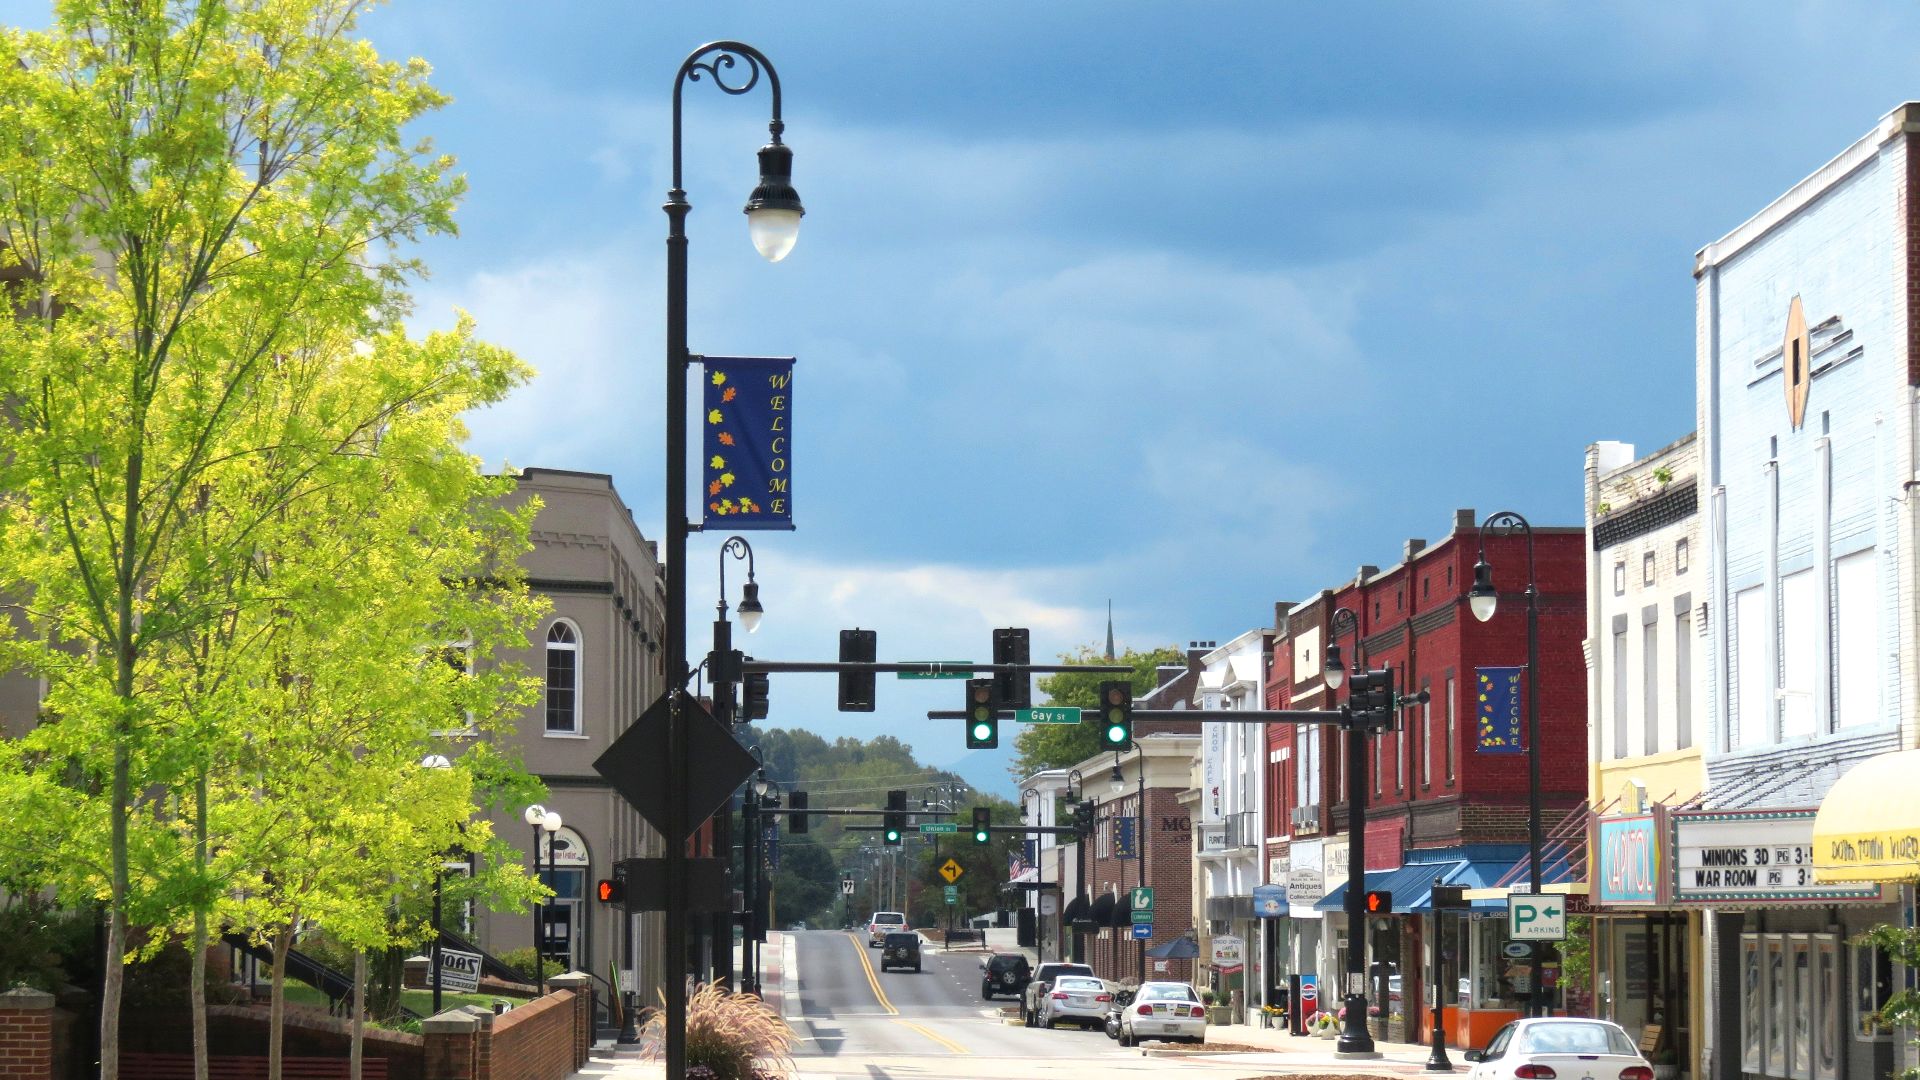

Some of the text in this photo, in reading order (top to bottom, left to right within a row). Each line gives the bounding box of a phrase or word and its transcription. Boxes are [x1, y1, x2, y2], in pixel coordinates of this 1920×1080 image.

[769, 370, 791, 514] WELCOME
[1031, 710, 1051, 722] Gay
[1508, 673, 1520, 746] WELCOME
[1606, 829, 1652, 894] CAPITOL
[1702, 848, 1747, 867] MINIONS
[1754, 848, 1769, 866] 3D
[1776, 850, 1789, 862] PG
[1289, 883, 1322, 891] Antiques
[1696, 870, 1720, 887] WAR
[1724, 869, 1757, 886] ROOM
[1768, 871, 1782, 883] PG
